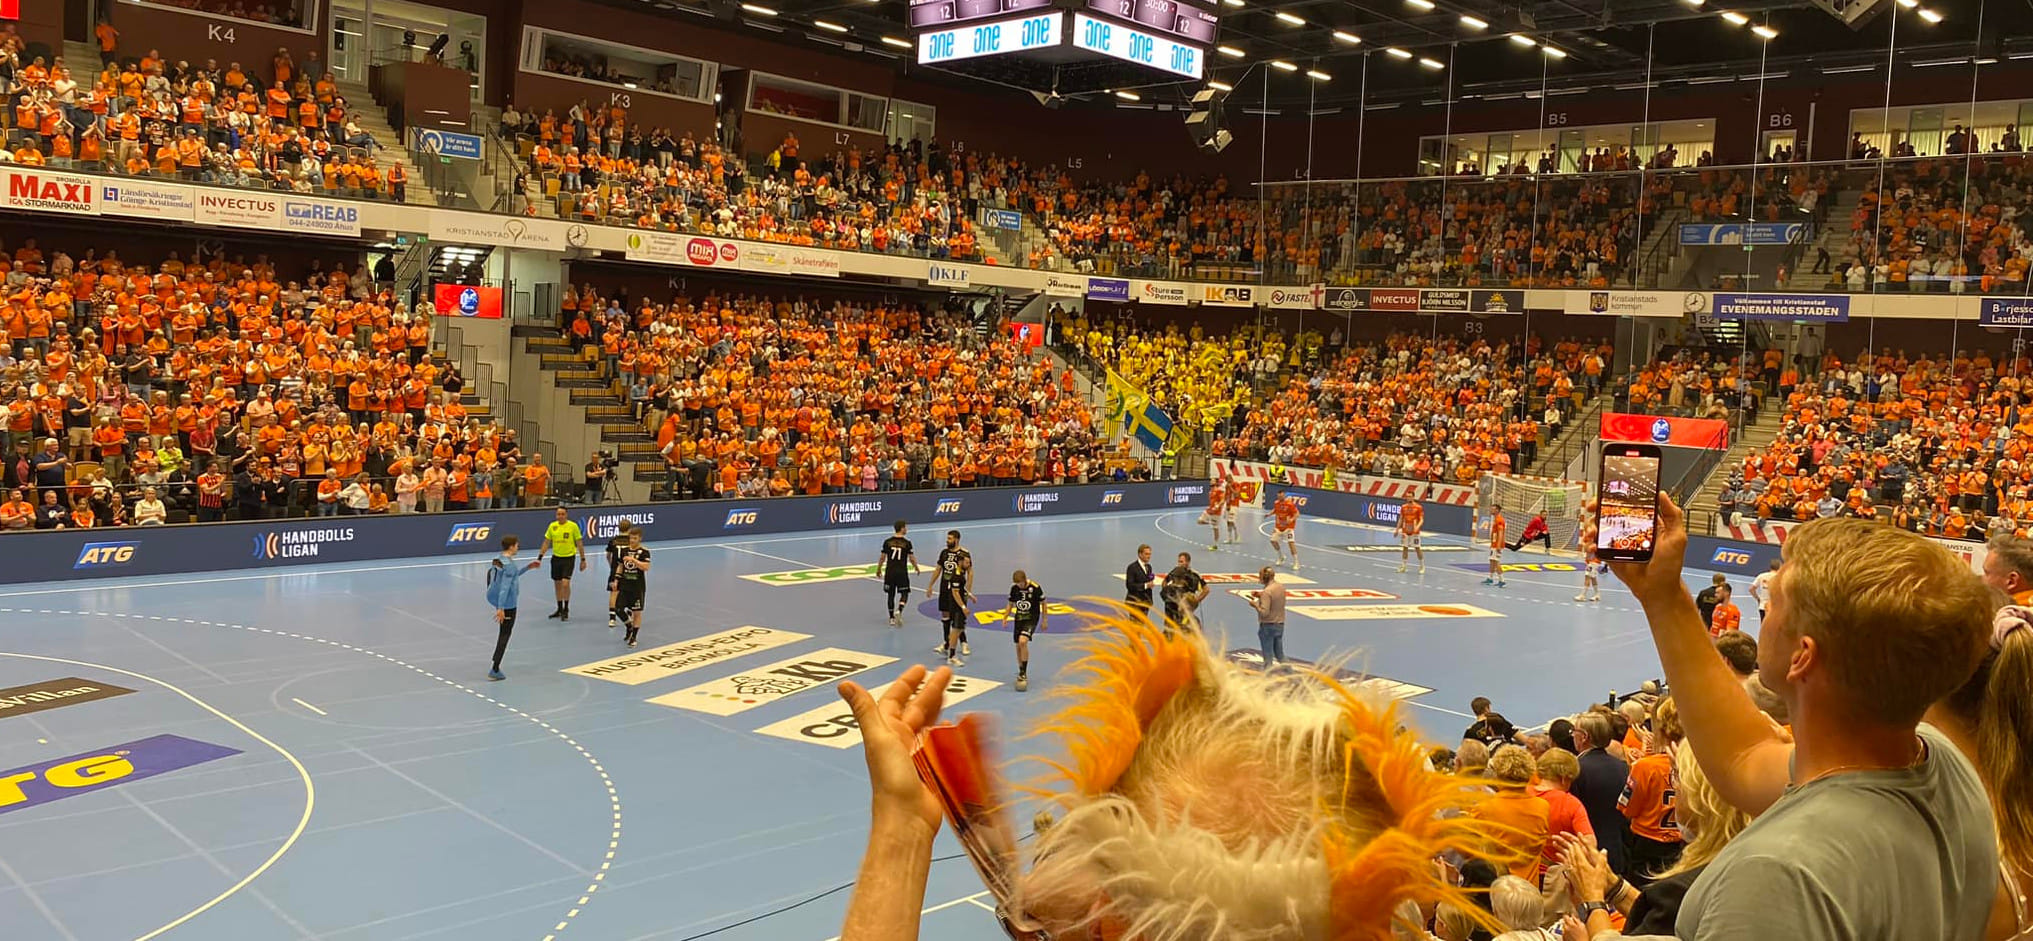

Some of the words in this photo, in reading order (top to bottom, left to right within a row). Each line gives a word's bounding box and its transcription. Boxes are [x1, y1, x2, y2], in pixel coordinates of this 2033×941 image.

[939, 6, 951, 19] 12
[1119, 1, 1129, 15] 12
[1179, 18, 1190, 33] 12
[208, 23, 236, 43] K4
[610, 92, 631, 109] K3
[1548, 112, 1568, 126] B5
[1769, 113, 1792, 127] B6
[835, 131, 850, 146] L7
[1067, 156, 1083, 169] L5
[9, 173, 92, 203] MAXI
[8, 198, 23, 206] ICA
[24, 198, 92, 212] STORMARKNAD
[200, 195, 276, 213] INVECTUS
[312, 204, 359, 223] REAB
[446, 227, 510, 239] KRISTIANSTAD
[521, 234, 550, 243] ARENA
[941, 267, 968, 281] KLF
[669, 277, 687, 290] K1
[1372, 295, 1417, 304] INVECTUS
[1611, 294, 1659, 304] Kristianstads
[1720, 304, 1839, 316] EVENEMANGSSTADEN
[1464, 321, 1484, 334] B3
[1024, 492, 1059, 504] HANDBOLLS
[1173, 485, 1204, 497] HANDBOLLS
[1102, 493, 1123, 504] ATG
[1173, 494, 1190, 504] LIGAN
[839, 501, 882, 514] HANDBOLLS
[936, 501, 961, 513] ATG
[1024, 502, 1043, 512] LIGAN
[726, 511, 757, 526] ATG
[838, 512, 861, 523] LIGAN
[1376, 511, 1398, 522] LIGAN
[282, 528, 355, 545] HANDBOLLS
[450, 525, 491, 542] ATG
[79, 546, 136, 565] ATG
[281, 543, 319, 558] LIGAN
[1713, 551, 1752, 566] ATG
[582, 627, 773, 677] HUSVAGNS-EXPO
